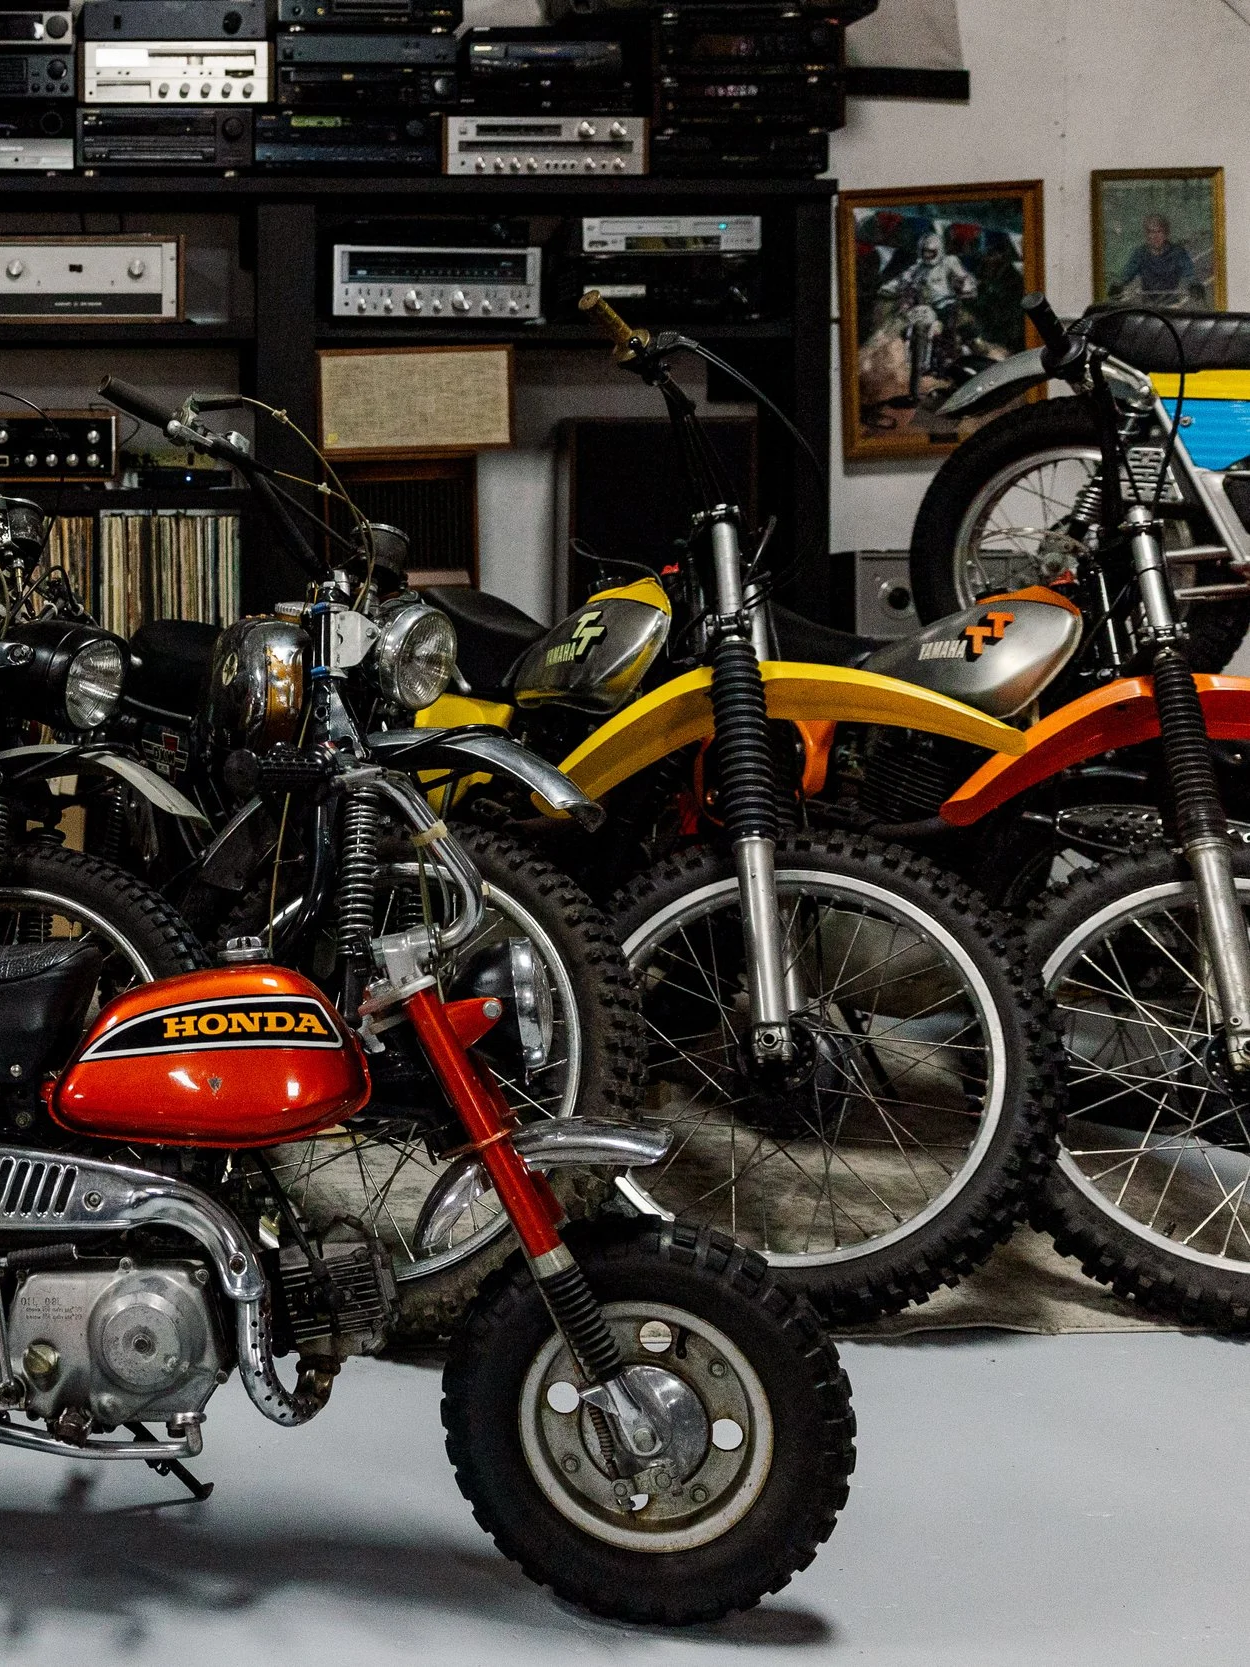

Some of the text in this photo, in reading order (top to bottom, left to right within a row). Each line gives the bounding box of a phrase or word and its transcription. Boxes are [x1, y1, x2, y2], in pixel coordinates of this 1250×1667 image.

[571, 610, 606, 656] TT
[965, 611, 1015, 655] TT
[545, 642, 577, 667] YAMAHA
[918, 639, 968, 661] YAMAHA
[163, 1012, 328, 1038] HONDA
